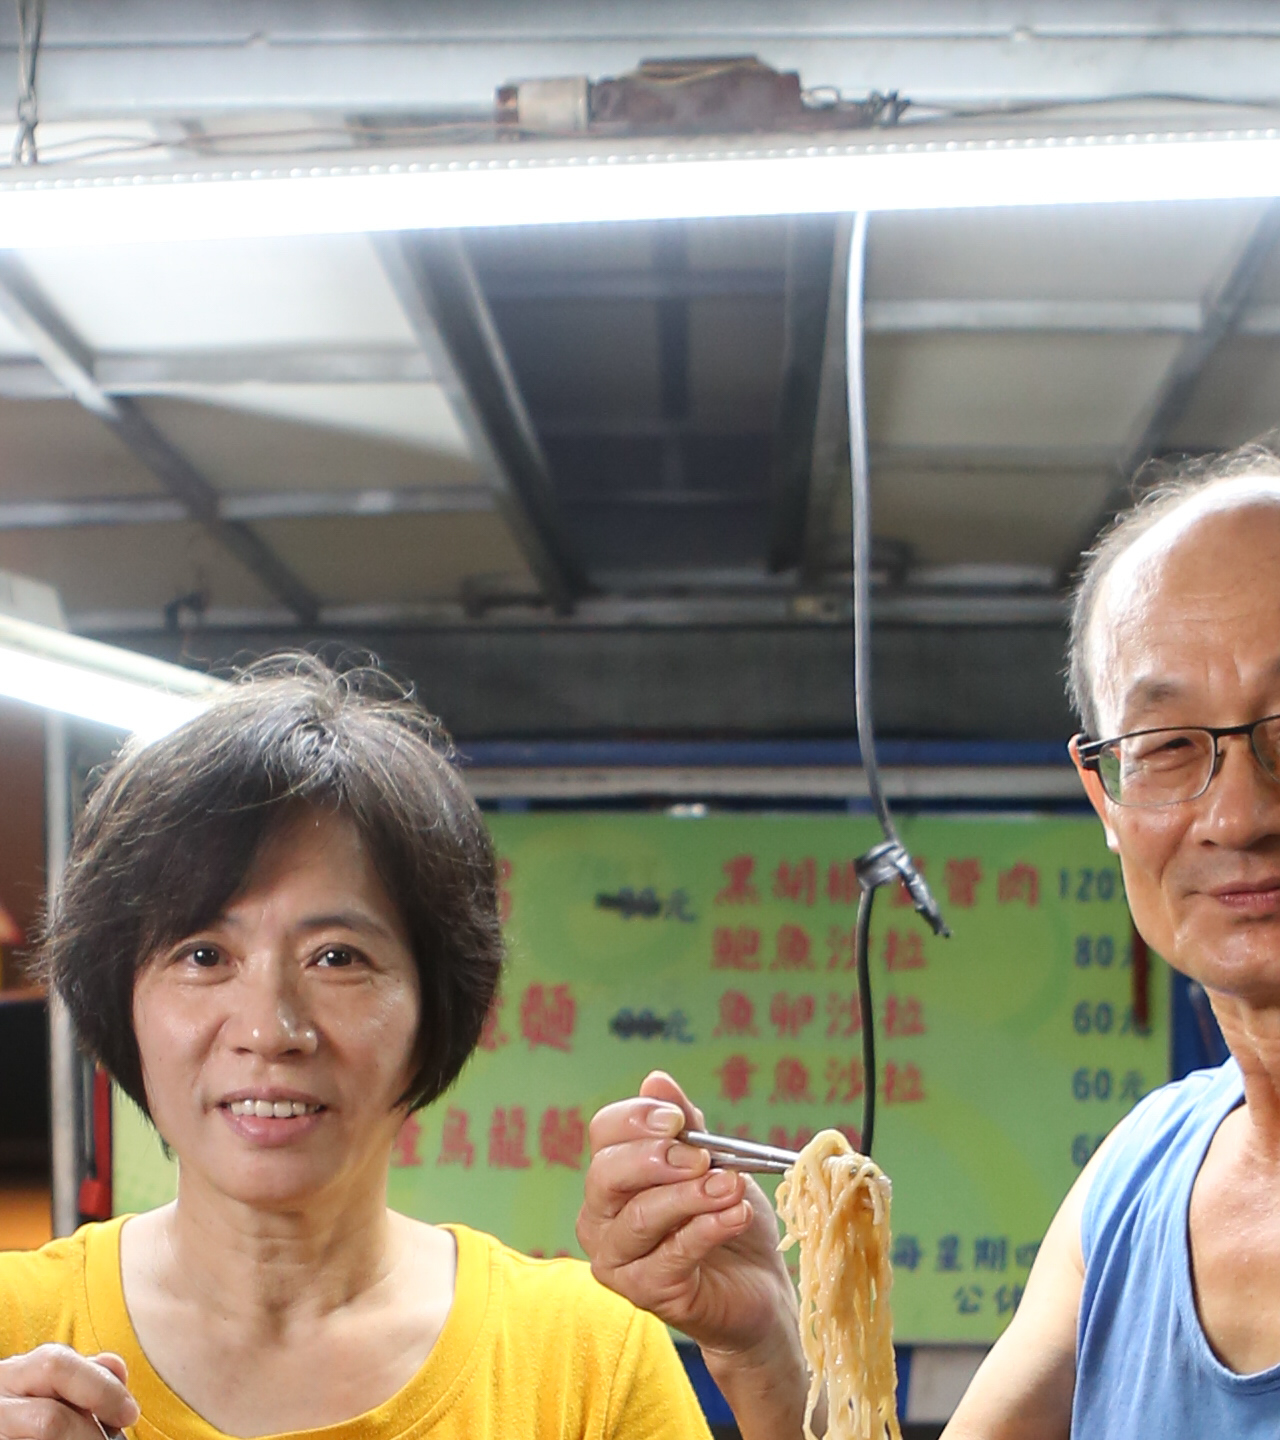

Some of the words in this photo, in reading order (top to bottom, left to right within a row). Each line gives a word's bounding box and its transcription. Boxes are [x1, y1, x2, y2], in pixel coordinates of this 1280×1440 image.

[715, 854, 1040, 908] 黑胡椒管肉
[1058, 867, 1126, 902] 120
